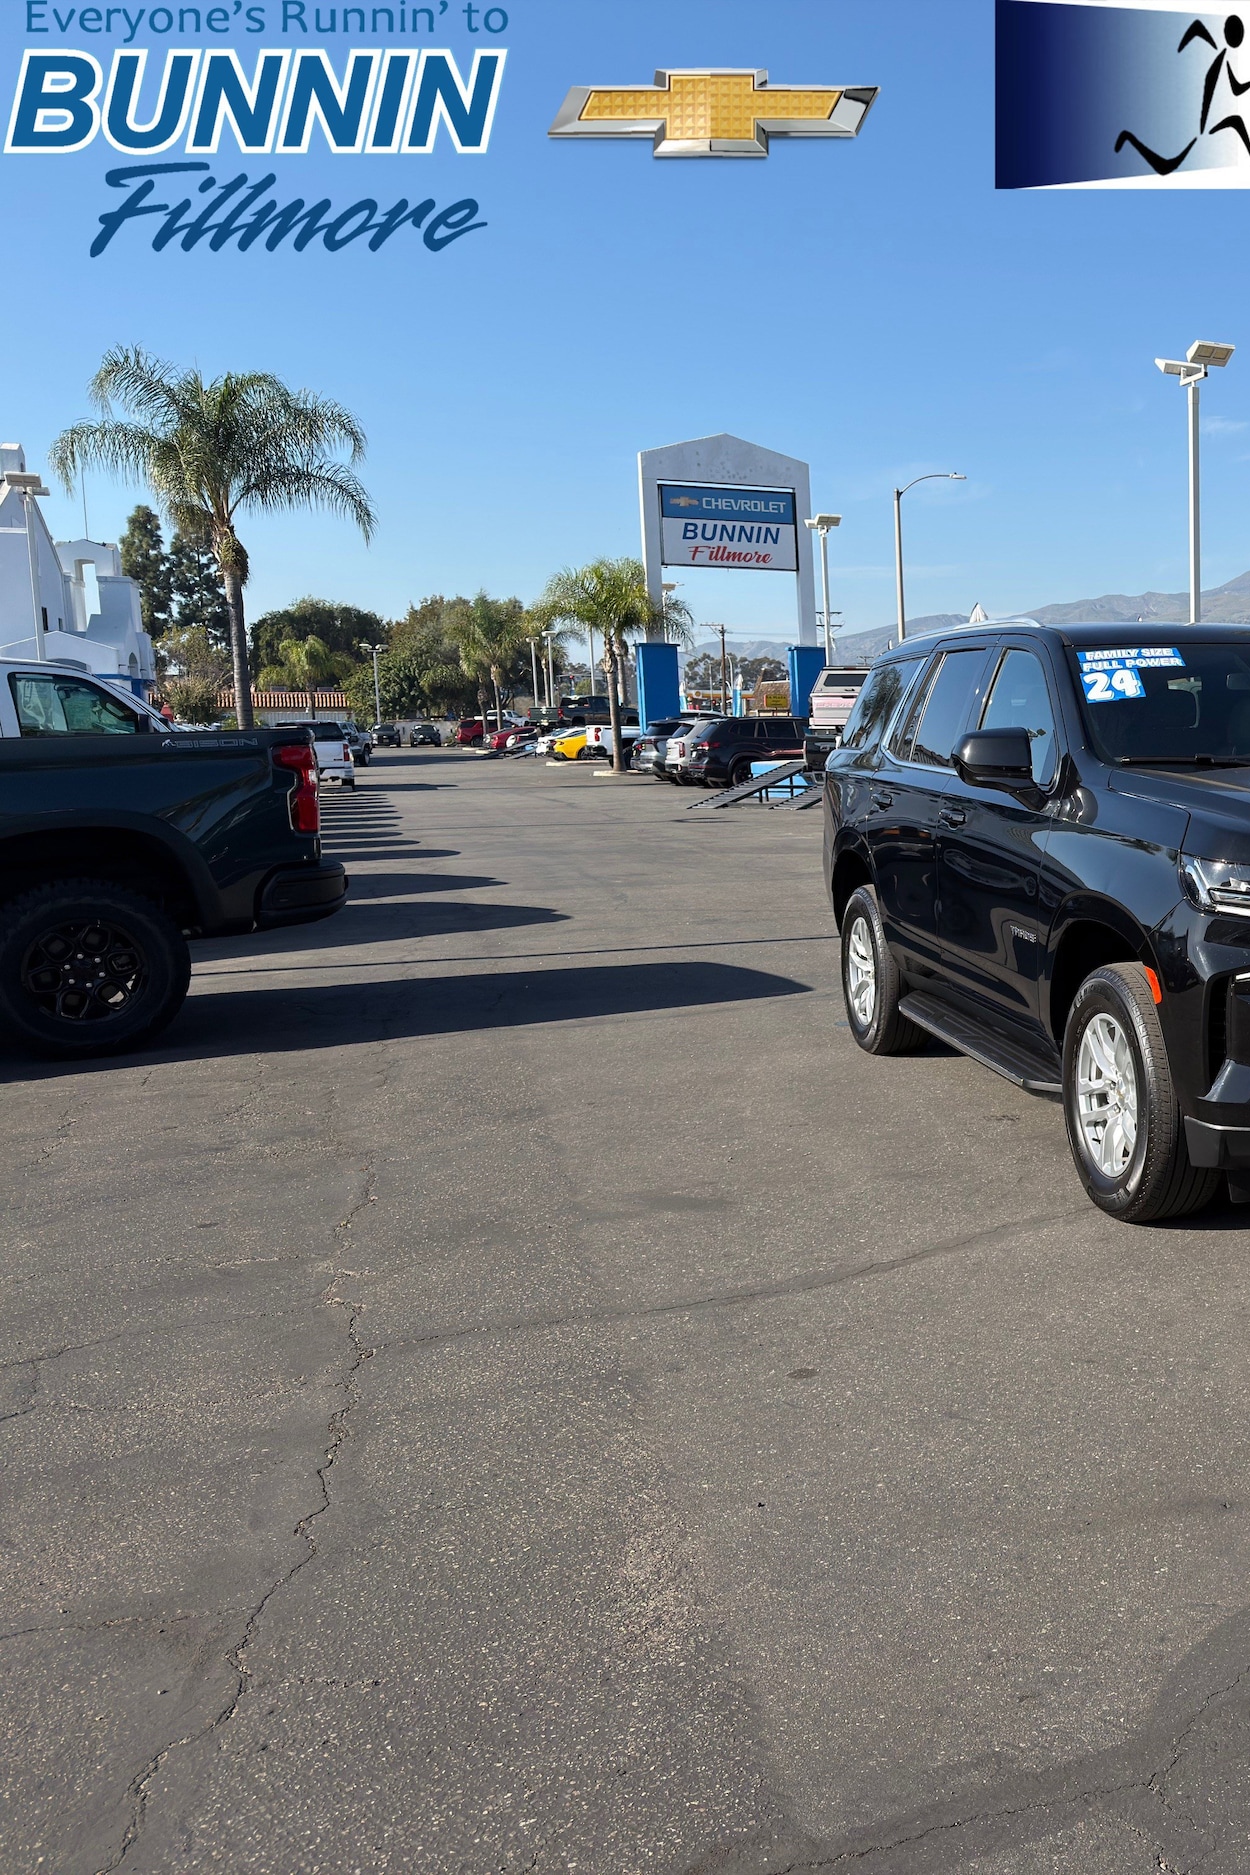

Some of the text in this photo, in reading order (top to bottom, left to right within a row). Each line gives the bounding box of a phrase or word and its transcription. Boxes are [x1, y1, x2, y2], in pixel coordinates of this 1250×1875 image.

[702, 497, 786, 513] CHEVROLET
[682, 522, 780, 545] BUNNIN
[688, 546, 773, 564] Fillmore
[1085, 647, 1174, 661] FAMILY SIZE
[1082, 657, 1183, 672] FULL POWER
[1083, 669, 1142, 700] 24
